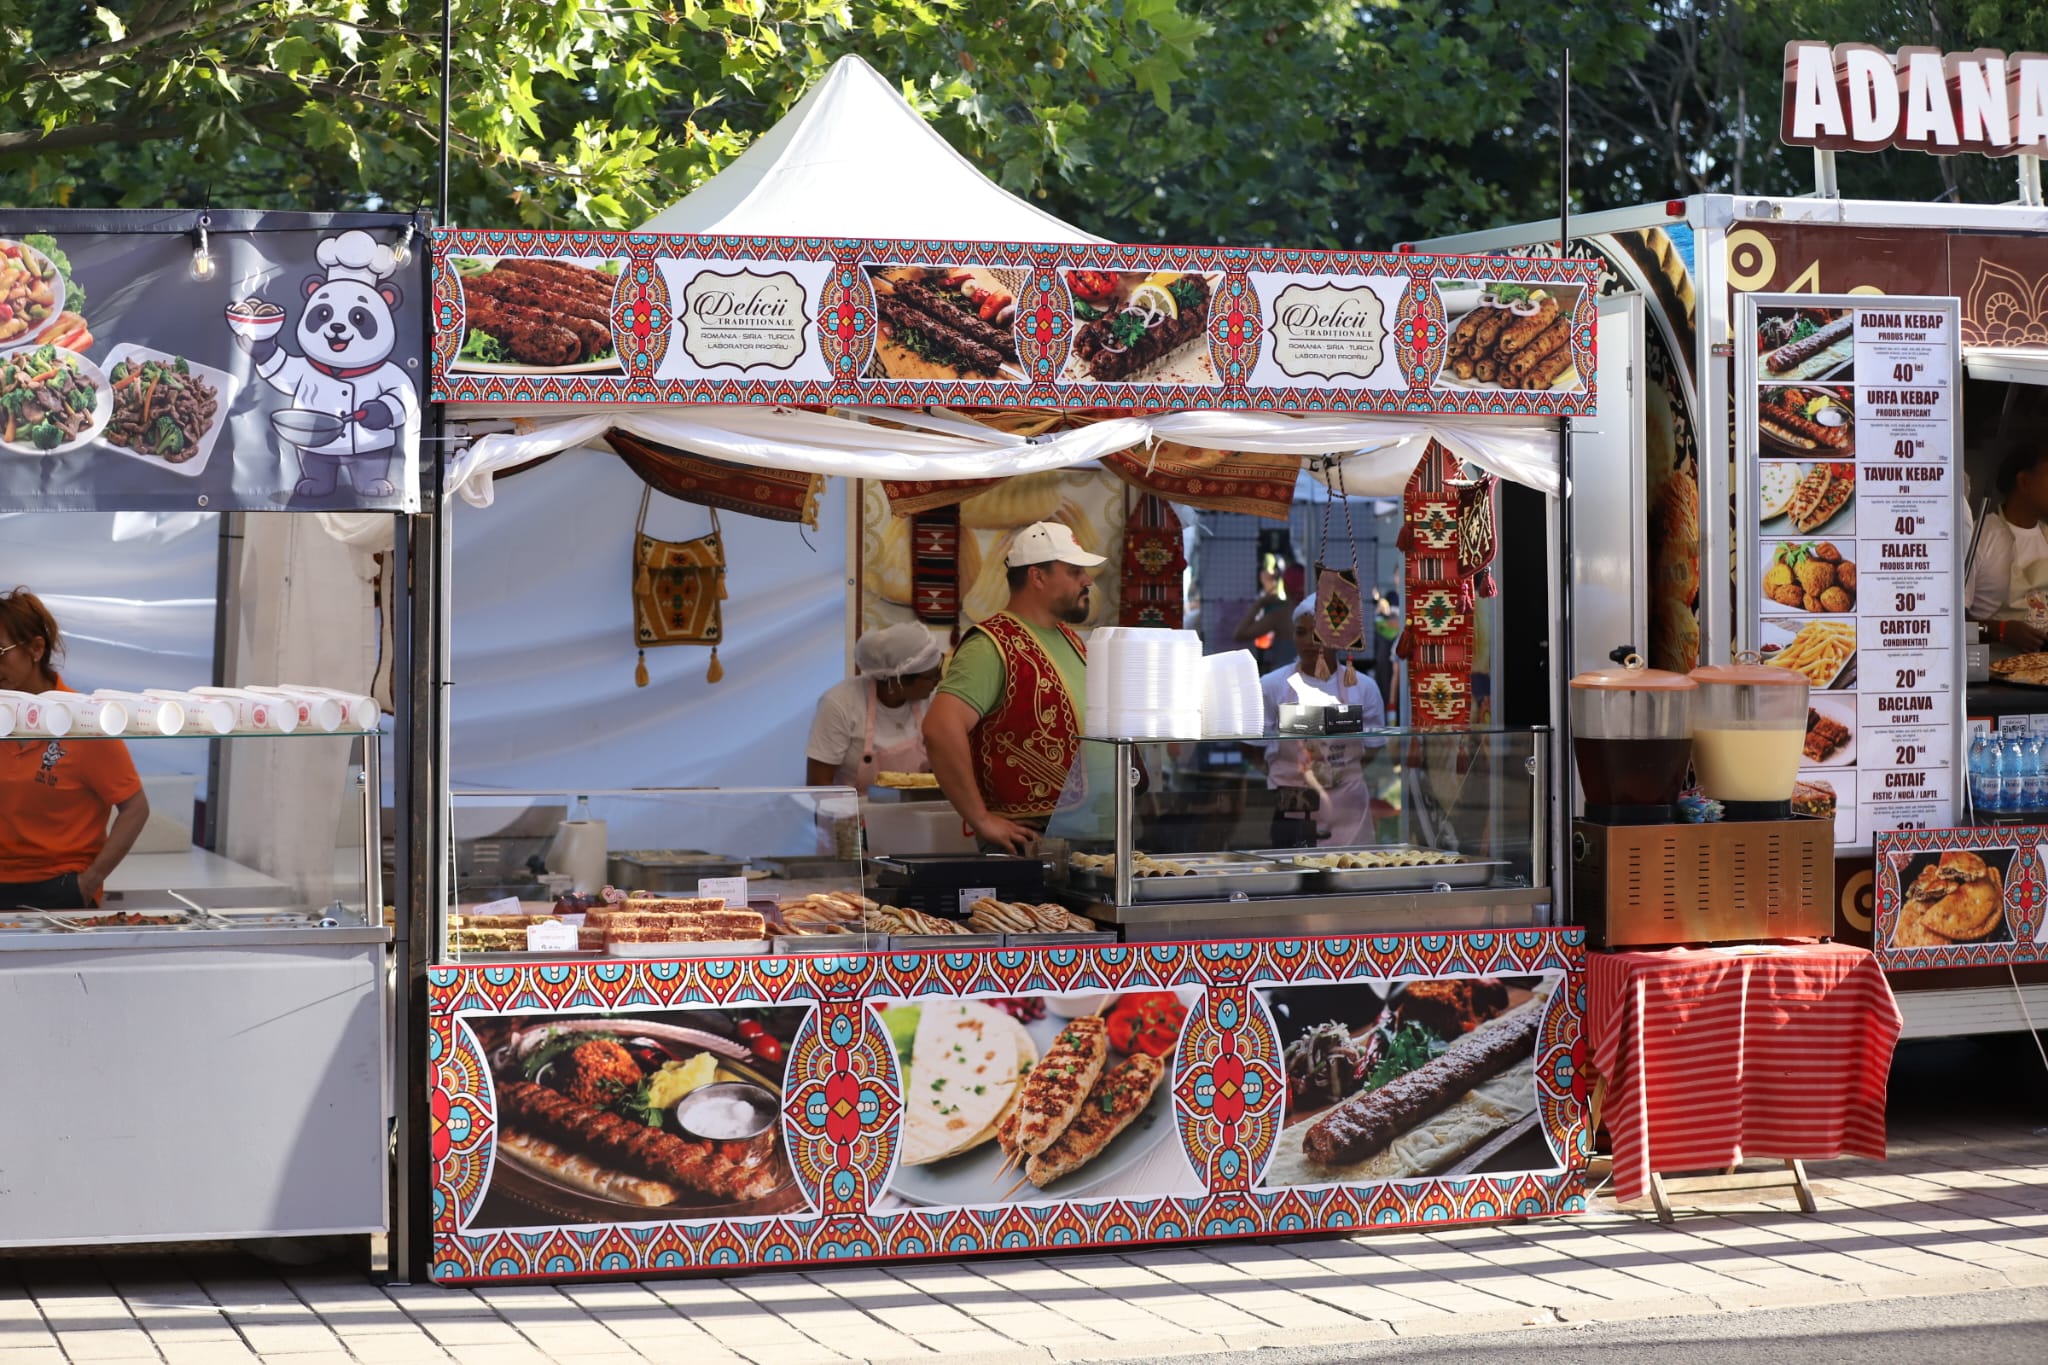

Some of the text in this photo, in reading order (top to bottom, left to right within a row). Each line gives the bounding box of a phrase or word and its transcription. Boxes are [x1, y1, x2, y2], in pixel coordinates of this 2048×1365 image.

[1793, 45, 2048, 146] ADANA
[693, 285, 789, 325] Delicii
[1282, 298, 1368, 336] Delicii
[1861, 314, 1943, 329] ADANA KEBAP
[768, 333, 795, 341] TURCIA
[1878, 332, 1927, 341] PRODUS PICANT
[1893, 364, 1924, 382] 40 lei
[1867, 390, 1940, 405] URFA KEBAP
[1876, 409, 1931, 417] PRODUS NEPICANT
[1894, 440, 1925, 459] 40 lei
[1864, 467, 1944, 481] TAVUK KEBAP
[1899, 485, 1910, 493] PUI
[1895, 516, 1925, 535] 40 lei
[1881, 544, 1928, 558] FALAFEL
[1880, 562, 1930, 570] PRODUS DE POST
[1895, 592, 1926, 612] 30 lei
[1880, 620, 1930, 634] CARTOFI
[1896, 669, 1926, 688] 20 lei
[1879, 696, 1933, 711] BACLAVA
[1892, 714, 1920, 723] CU LAPTE
[1896, 745, 1926, 765] 20 lei
[1885, 773, 1926, 787] CATAIF
[1873, 791, 1893, 800] FISTIC
[1920, 790, 1938, 799] LAPTE
[1917, 821, 1926, 829] lei
